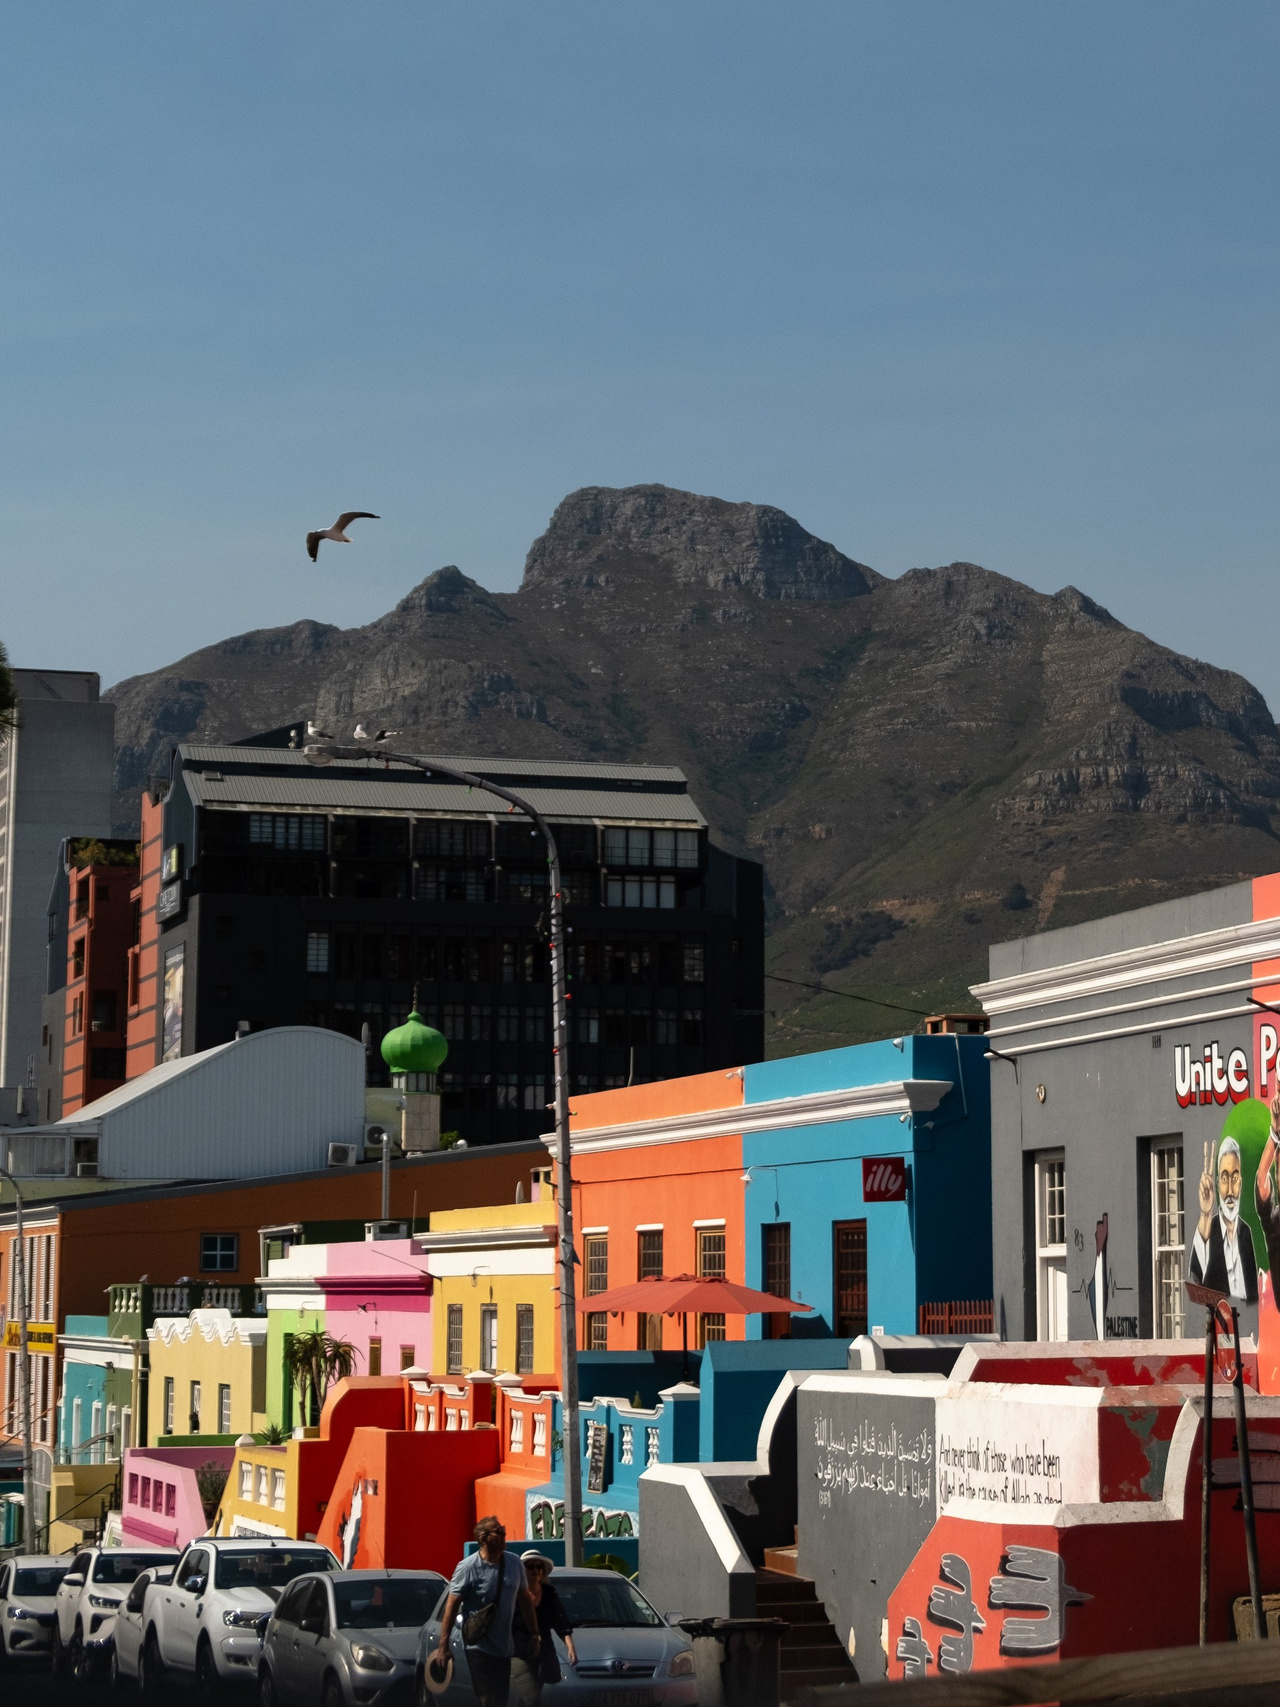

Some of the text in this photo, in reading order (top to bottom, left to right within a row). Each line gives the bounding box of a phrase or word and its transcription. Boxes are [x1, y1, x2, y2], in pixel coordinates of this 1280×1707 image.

[1174, 1040, 1250, 1108] Unite
[865, 1164, 903, 1198] illy
[1074, 1228, 1084, 1252] 83
[1105, 1316, 1138, 1338] PALESTINE
[939, 1433, 1060, 1479] And never think of those who have been
[530, 1500, 565, 1540] FRE
